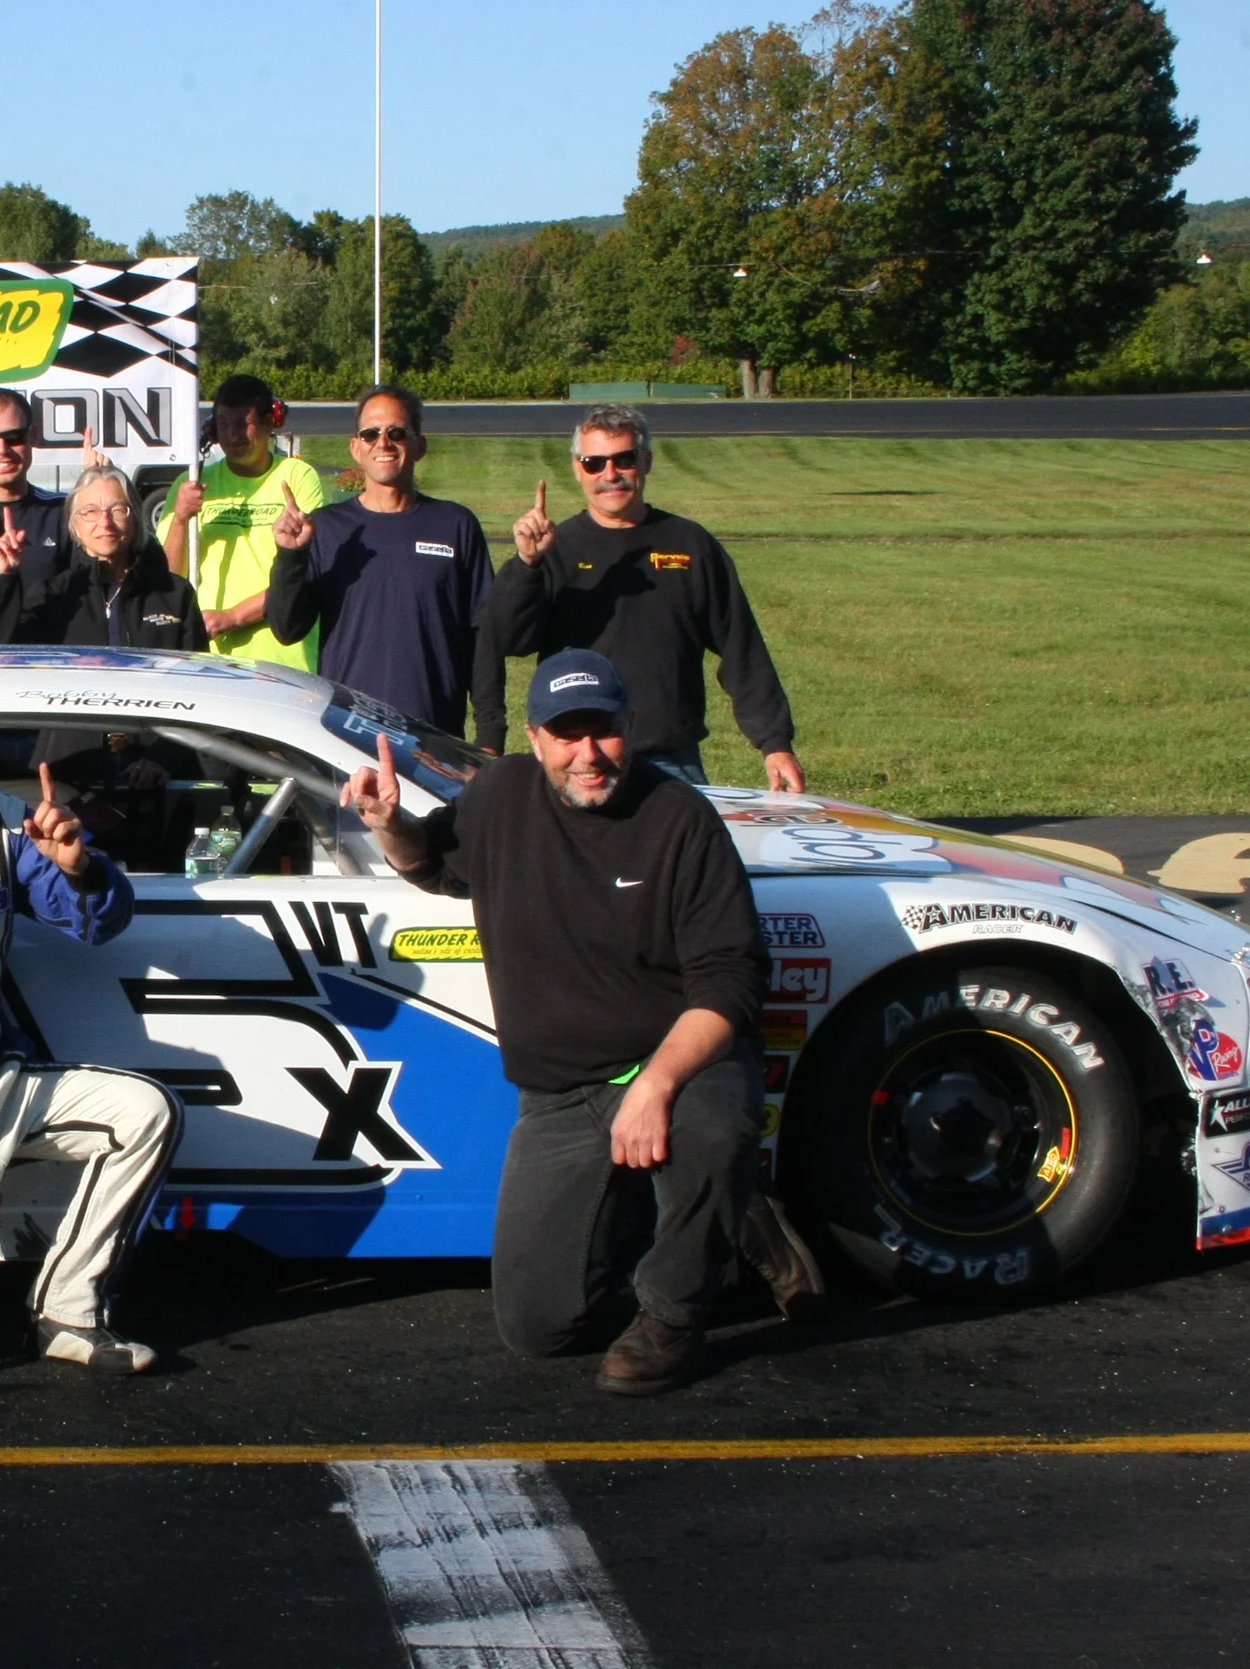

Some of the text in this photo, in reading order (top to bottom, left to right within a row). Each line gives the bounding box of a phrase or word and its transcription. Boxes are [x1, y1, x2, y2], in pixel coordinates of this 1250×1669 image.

[15, 689, 118, 701] Bobby
[47, 697, 197, 711] THERRIEN
[918, 902, 1078, 935] AMERICAN
[288, 901, 380, 969] VT
[973, 924, 1024, 934] RACER
[398, 933, 468, 947] THUNDER
[883, 984, 1105, 1071] AMERICAN
[1212, 1047, 1239, 1072] Racing
